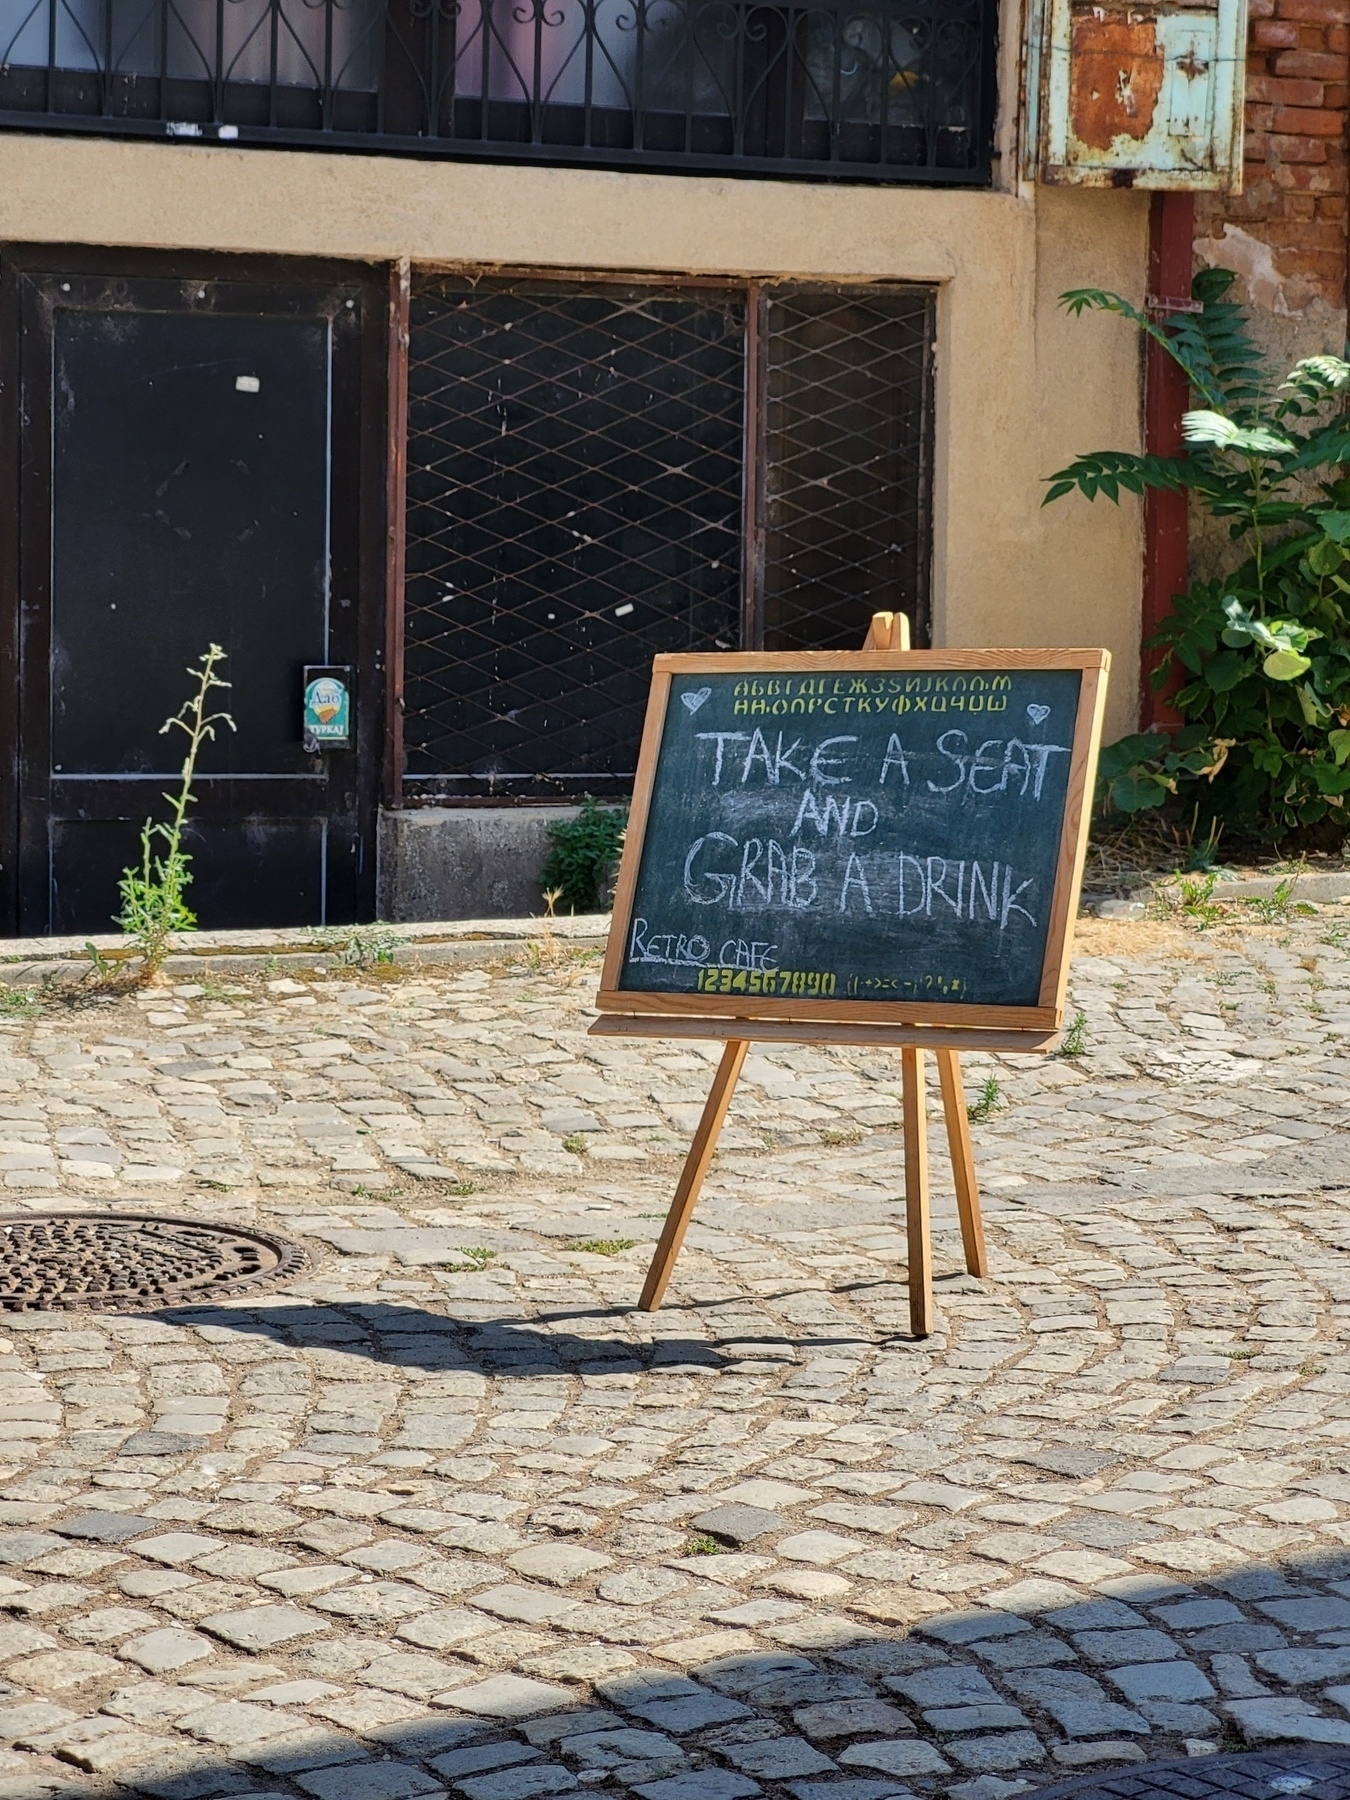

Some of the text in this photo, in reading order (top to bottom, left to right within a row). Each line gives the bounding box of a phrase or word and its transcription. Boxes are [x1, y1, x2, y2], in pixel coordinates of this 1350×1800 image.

[694, 727, 1072, 802] TAKE A SEAT
[788, 788, 878, 837] AND
[683, 831, 1037, 930] GRAB A DRINK
[630, 917, 711, 962] RETRO
[697, 968, 836, 996] 1234567890
